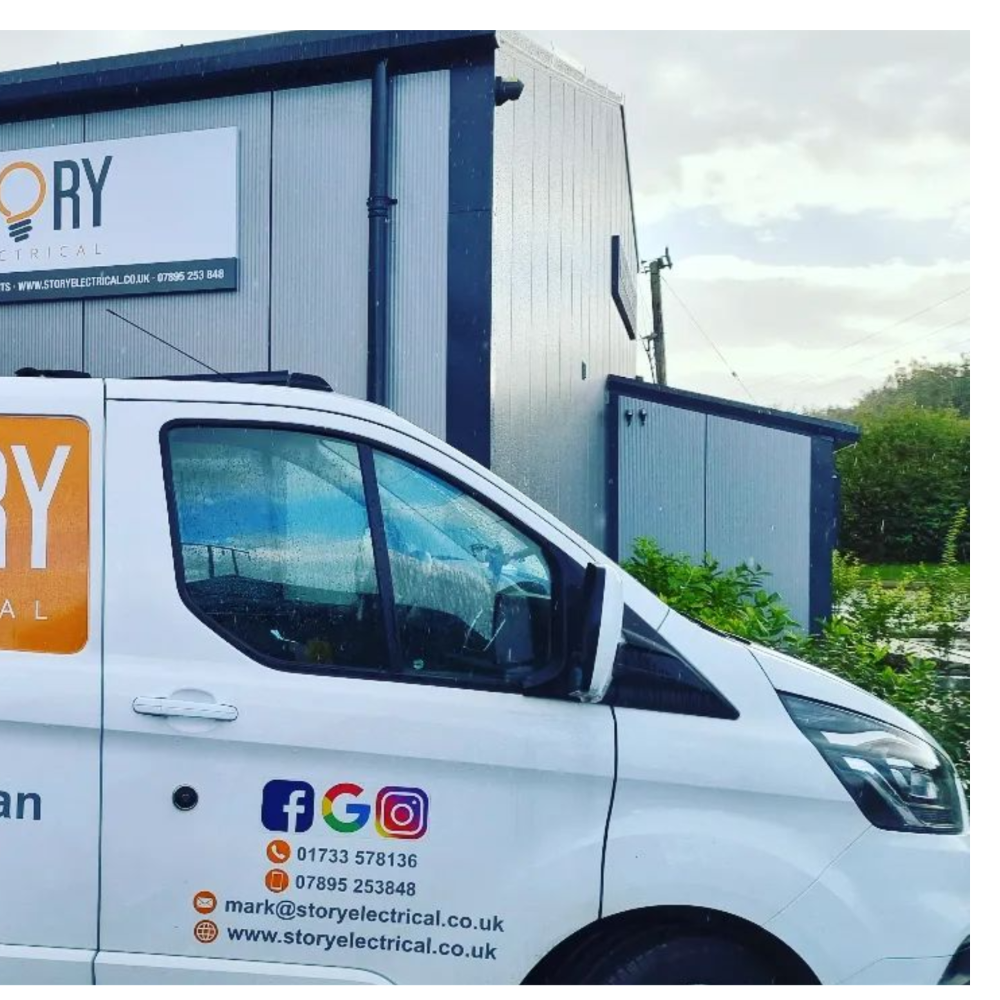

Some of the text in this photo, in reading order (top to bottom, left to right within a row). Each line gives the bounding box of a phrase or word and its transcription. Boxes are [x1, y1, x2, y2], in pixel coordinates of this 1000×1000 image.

[17, 273, 150, 291] WWW.STORYELECTRICAL.CO.UK
[157, 272, 185, 283] 07895
[187, 271, 204, 281] 253
[207, 269, 224, 279] 848
[296, 846, 418, 868] 01733 578136
[295, 875, 416, 897] 07895 253848
[224, 898, 505, 933] mark@storyelectrical.co.uk
[227, 925, 498, 960] www.storyelectrical.co.uk
